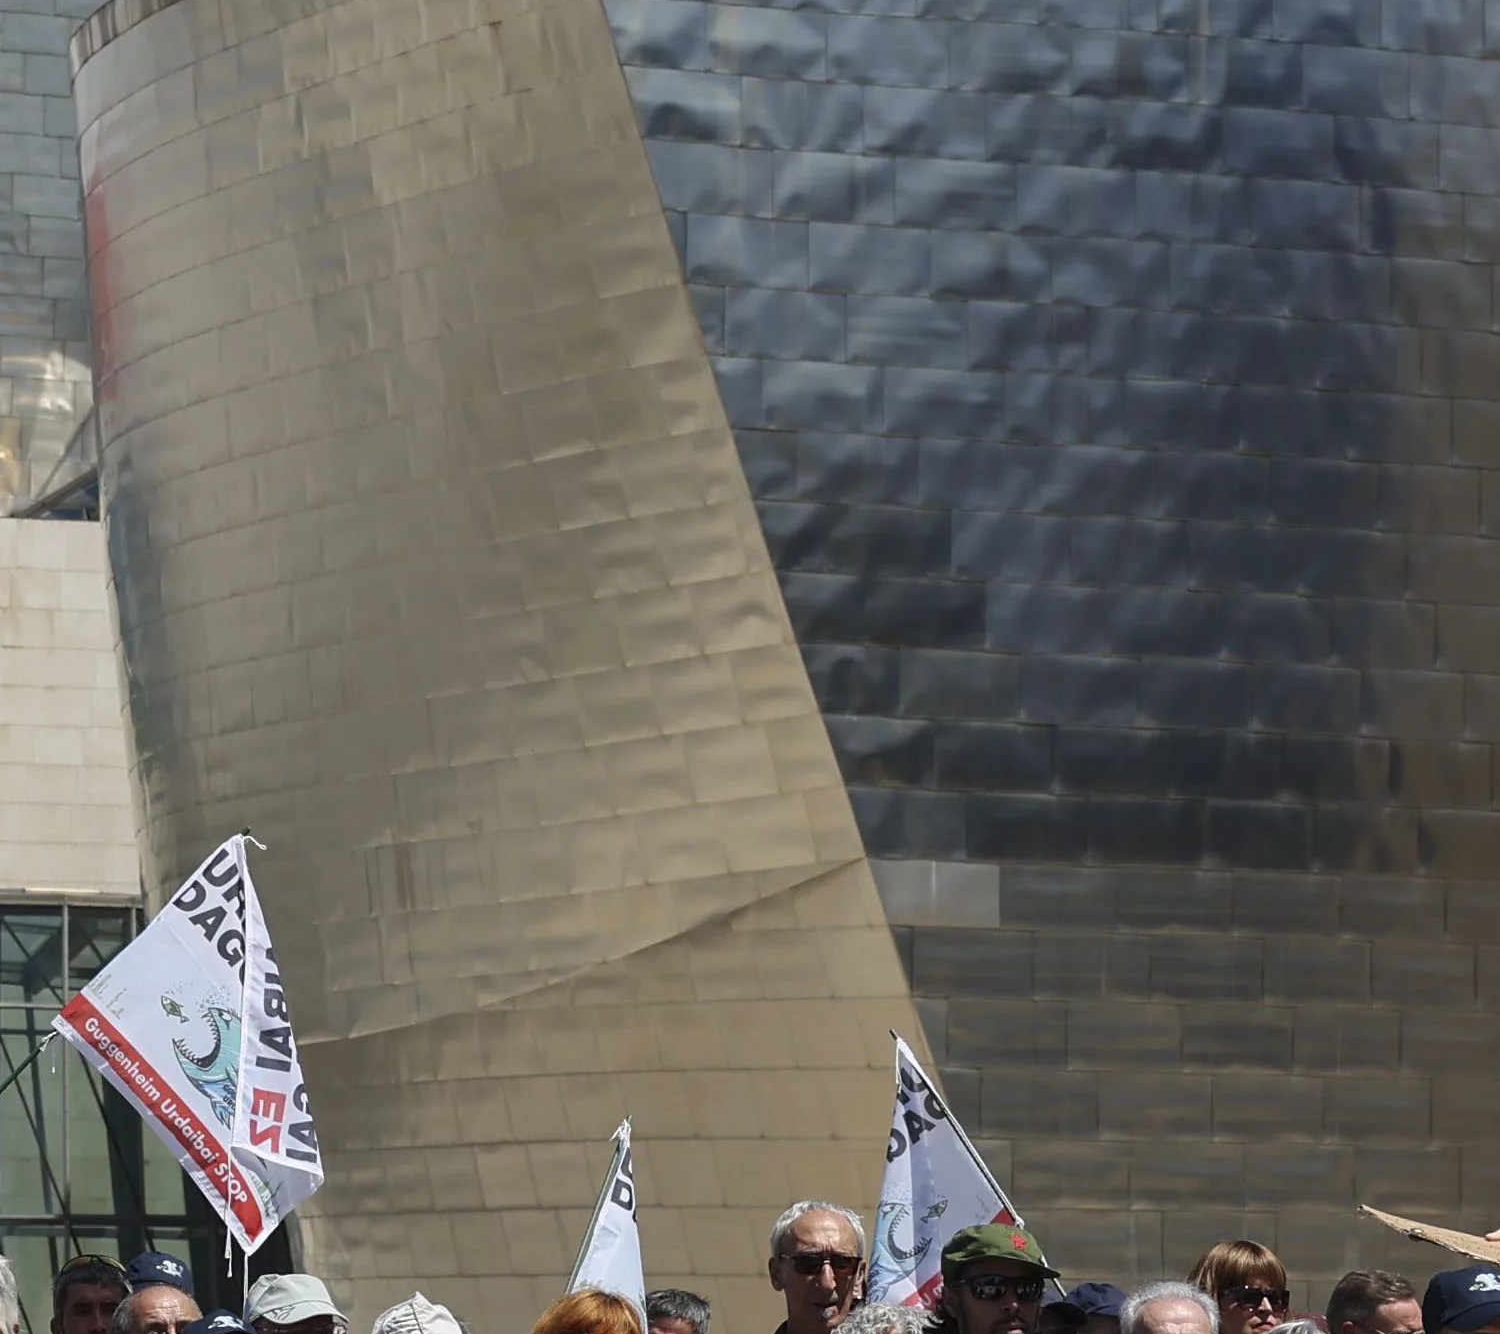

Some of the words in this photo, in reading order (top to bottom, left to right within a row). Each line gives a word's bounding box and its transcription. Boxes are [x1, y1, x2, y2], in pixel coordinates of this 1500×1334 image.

[172, 880, 246, 987] DAG
[84, 1017, 161, 1101] Guggenheim
[160, 1098, 221, 1164] Urdaibai
[214, 1162, 249, 1204] STOP
